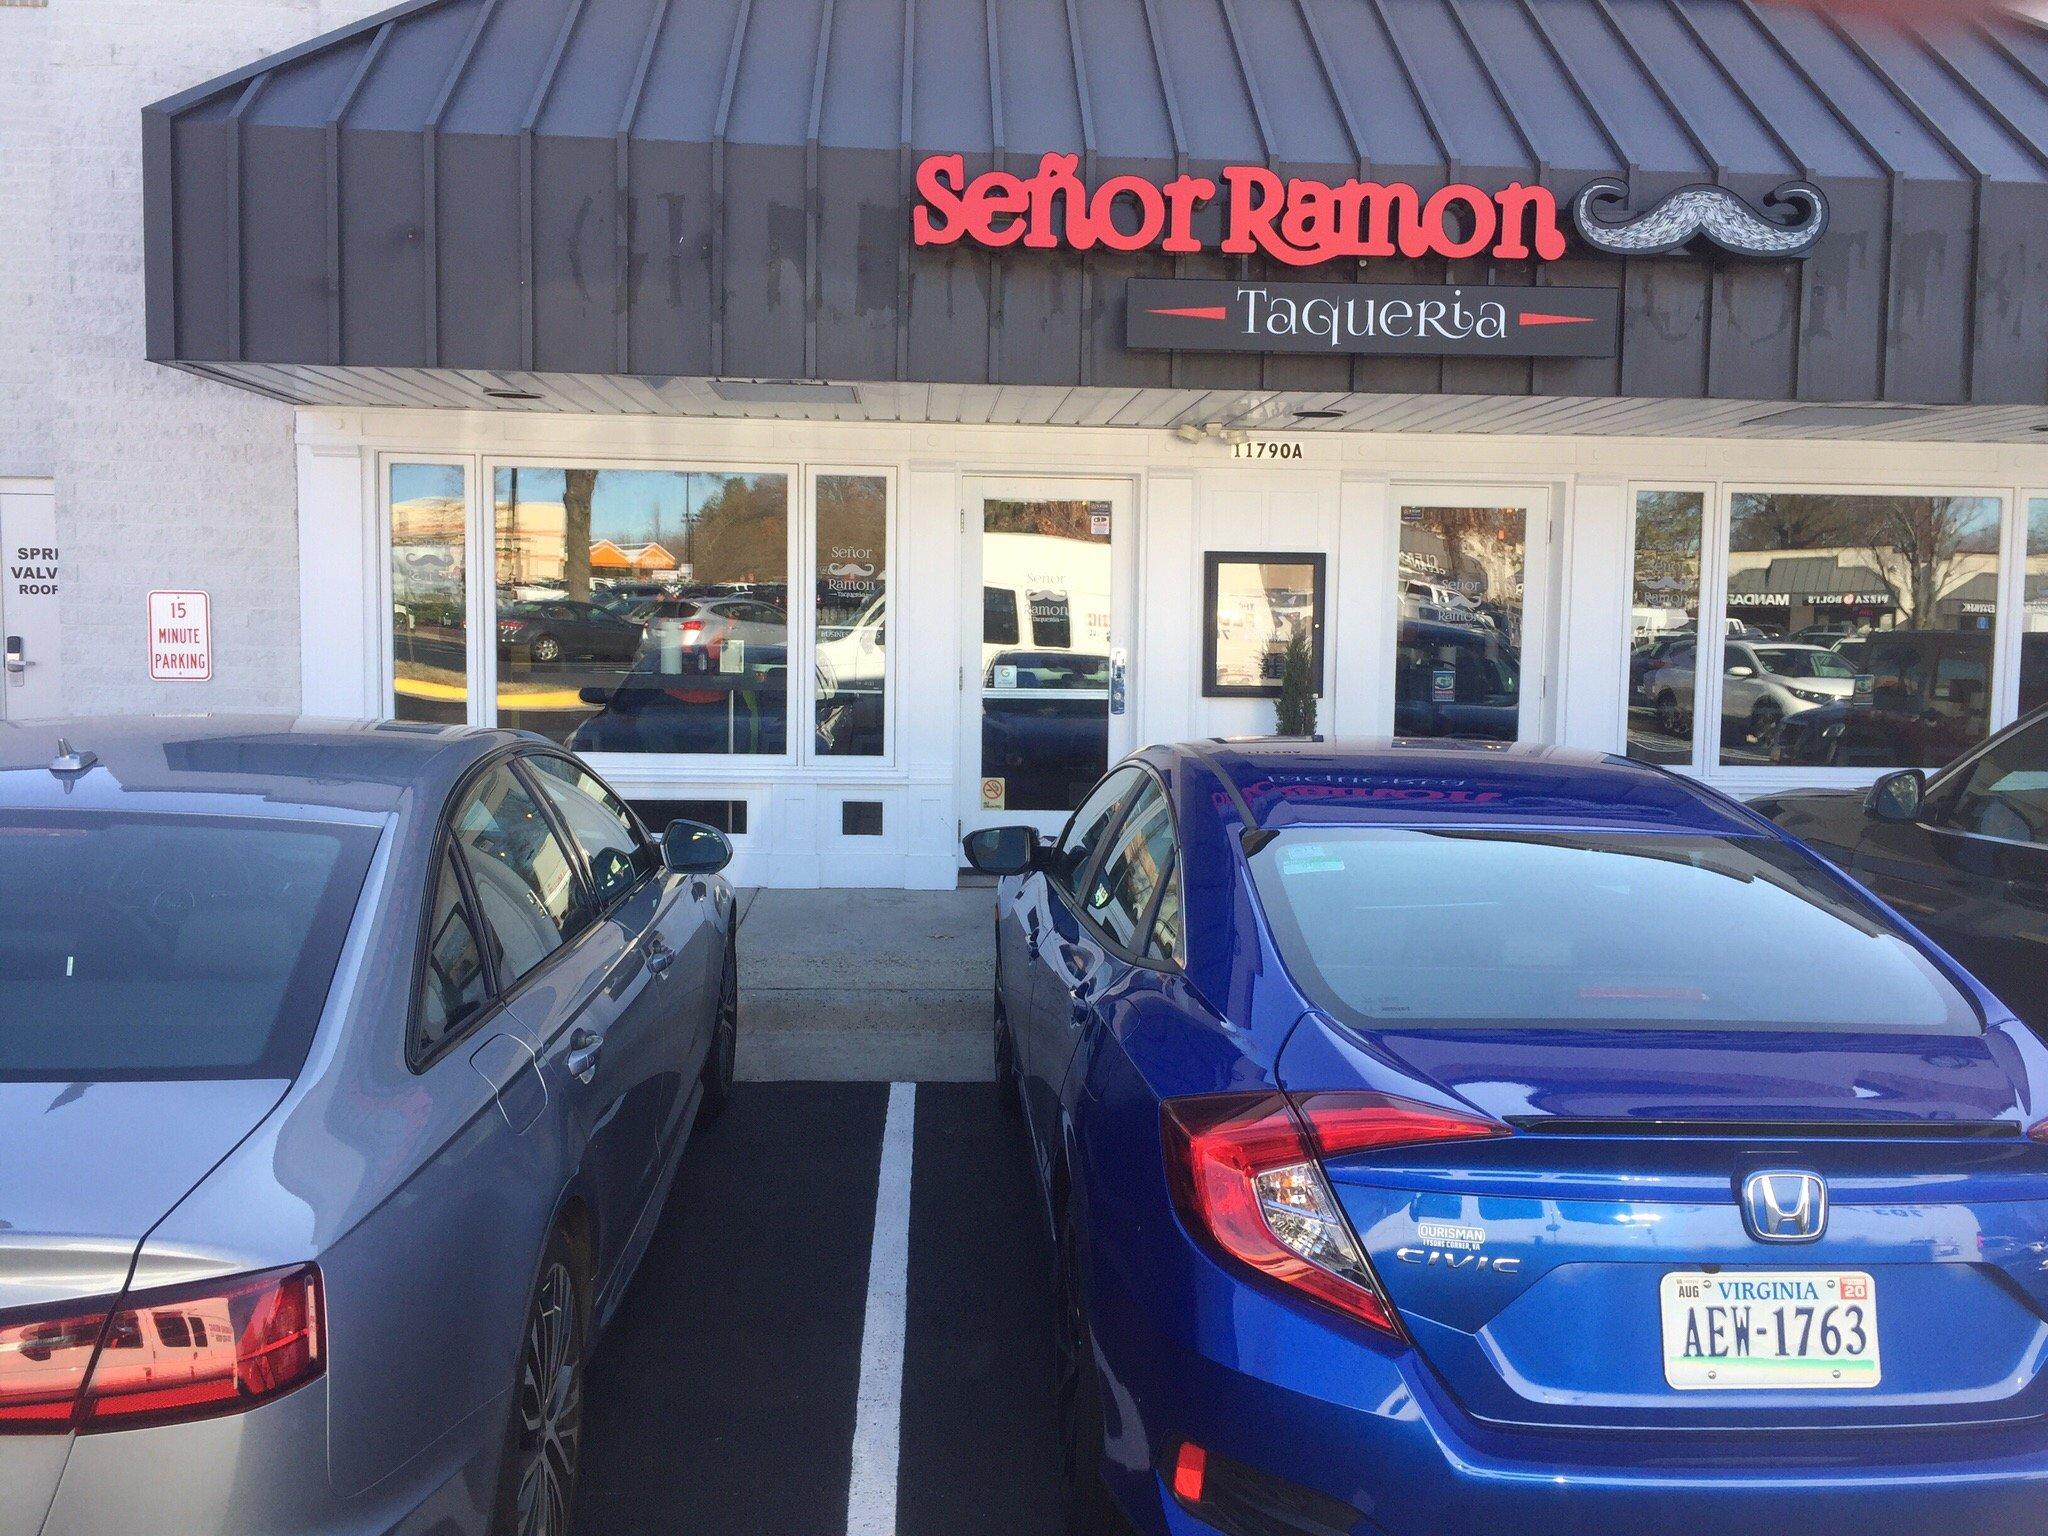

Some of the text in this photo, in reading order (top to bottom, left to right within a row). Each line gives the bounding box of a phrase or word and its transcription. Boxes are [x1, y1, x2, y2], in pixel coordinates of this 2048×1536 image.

[913, 152, 1566, 267] Señor Ramon
[1237, 286, 1508, 347] Taqueria
[1234, 442, 1302, 459] 11790A
[831, 545, 873, 559] Señor
[827, 578, 876, 591] Ramon
[170, 603, 187, 618] 15
[158, 628, 201, 644] MINUTE
[155, 653, 206, 669] PARKING
[1420, 1224, 1484, 1241] OURISMAN
[1397, 1247, 1520, 1273] CIVIC
[1678, 1285, 1699, 1298] AUG
[1718, 1281, 1820, 1300] VIRGINIA
[1683, 1304, 1866, 1357] AEW-1763
